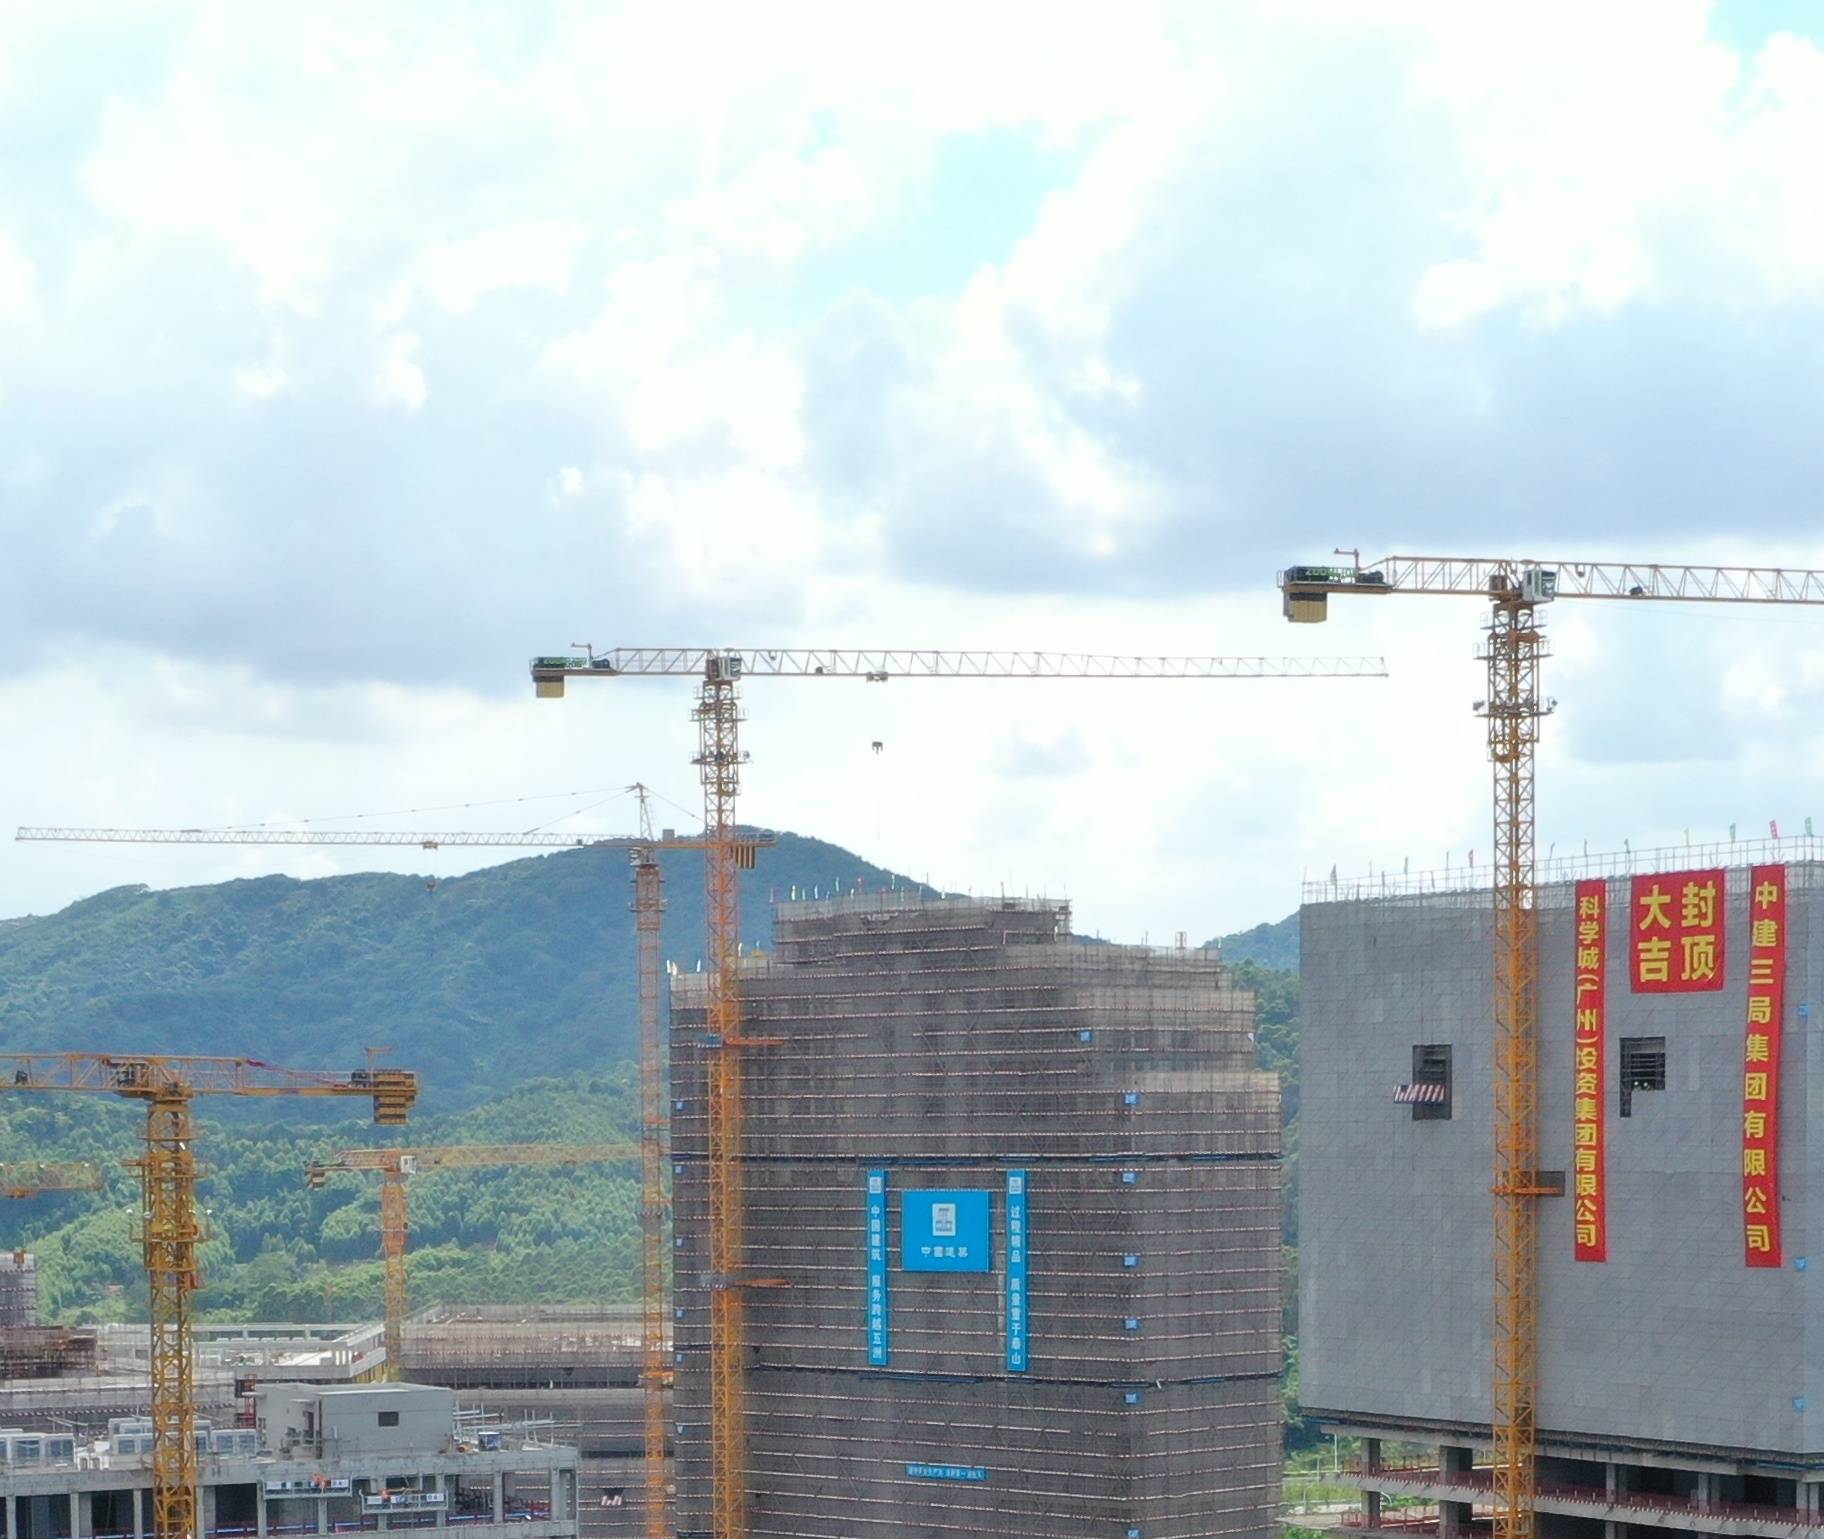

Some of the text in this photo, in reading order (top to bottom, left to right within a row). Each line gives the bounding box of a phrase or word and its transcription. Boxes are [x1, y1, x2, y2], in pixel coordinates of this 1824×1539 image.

[1743, 880, 1778, 1253] 中建三局集团有限公司
